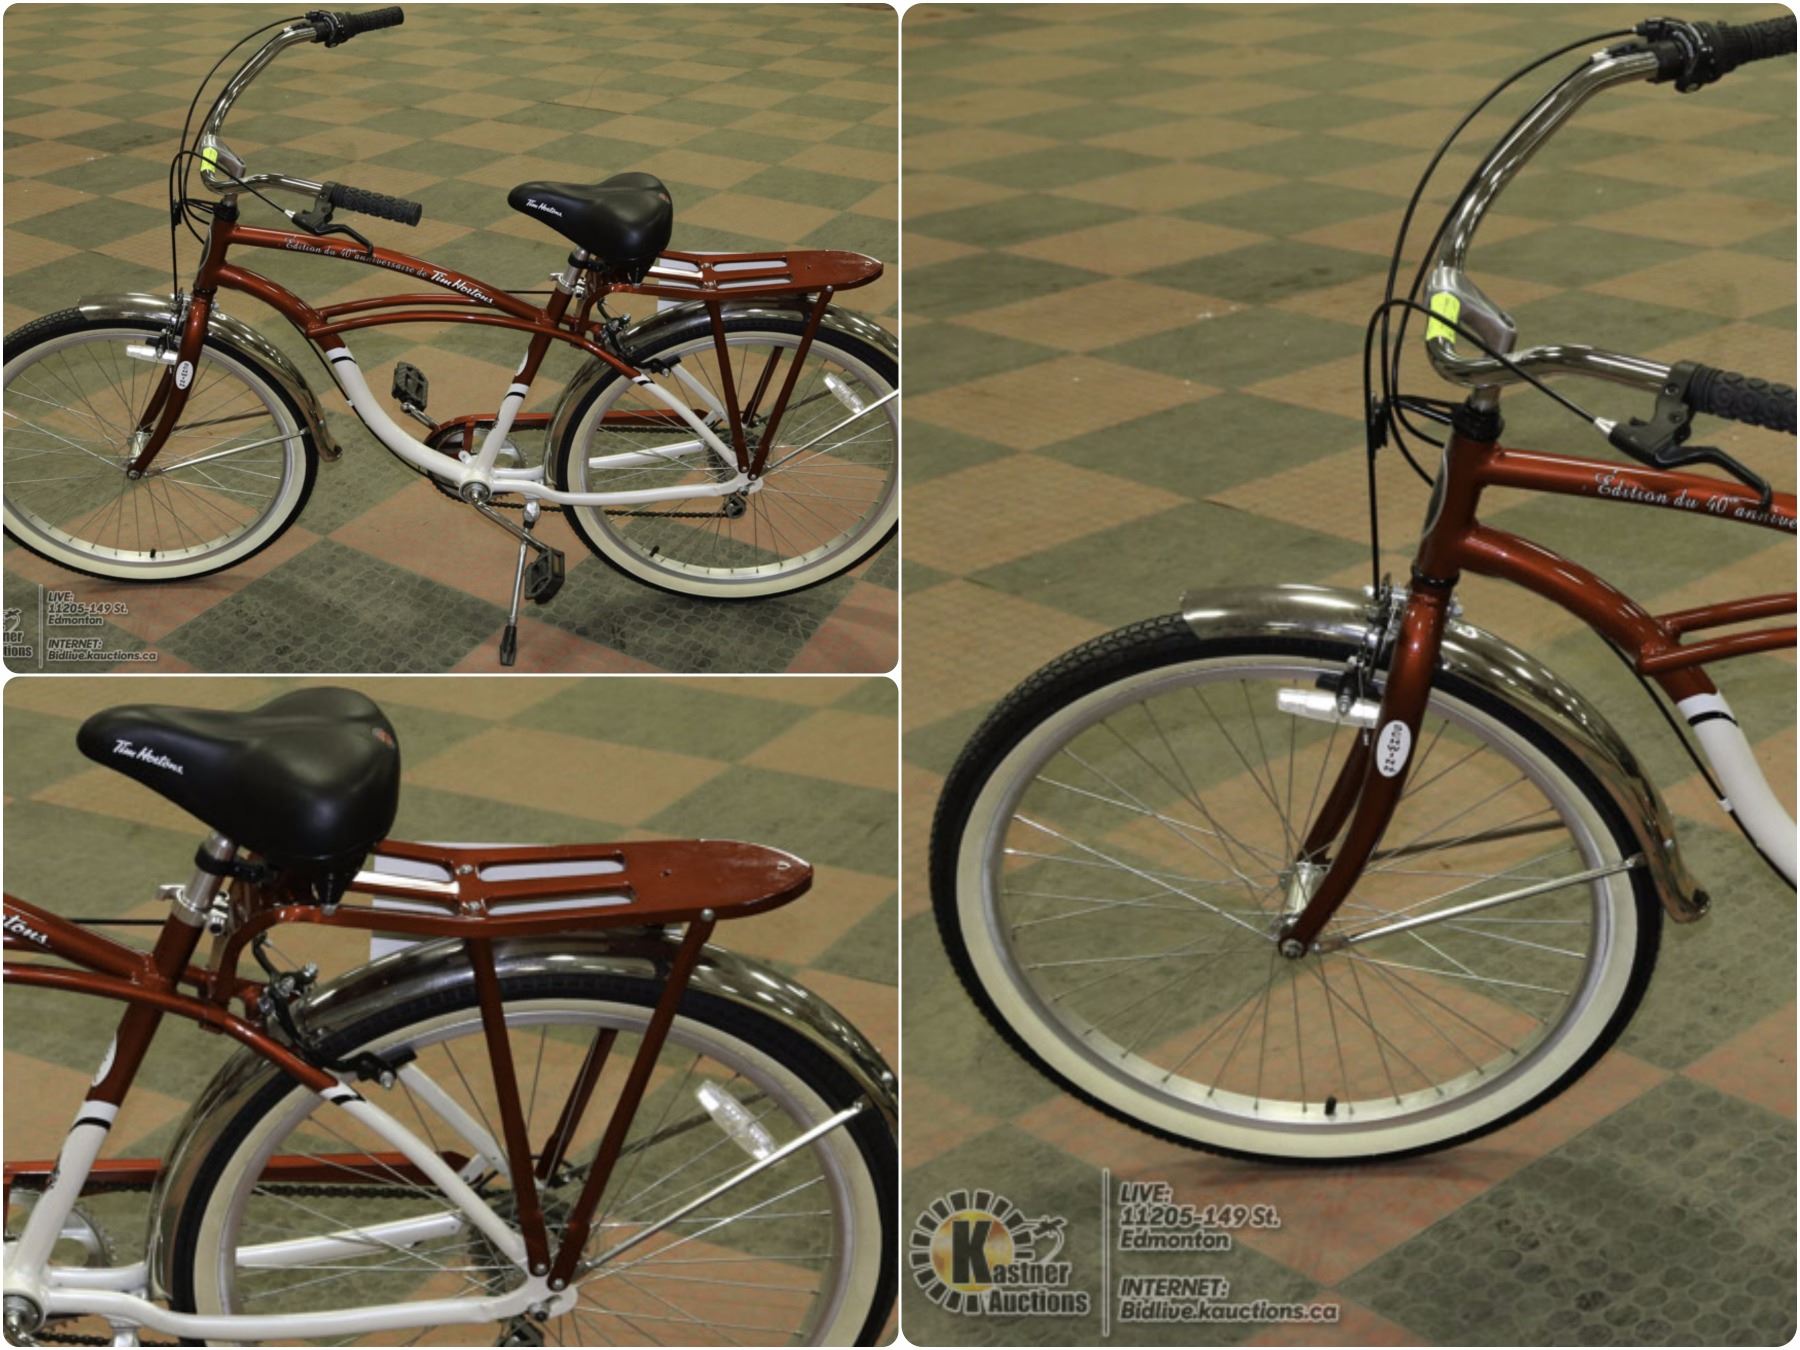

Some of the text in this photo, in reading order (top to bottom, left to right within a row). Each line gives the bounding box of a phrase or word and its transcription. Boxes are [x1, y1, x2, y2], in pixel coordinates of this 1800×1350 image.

[323, 245, 336, 256] du
[416, 266, 427, 278] de
[430, 269, 452, 287] Tim
[450, 278, 494, 305] Hortons
[1673, 488, 1698, 508] du
[113, 738, 184, 776] Tim Hortons
